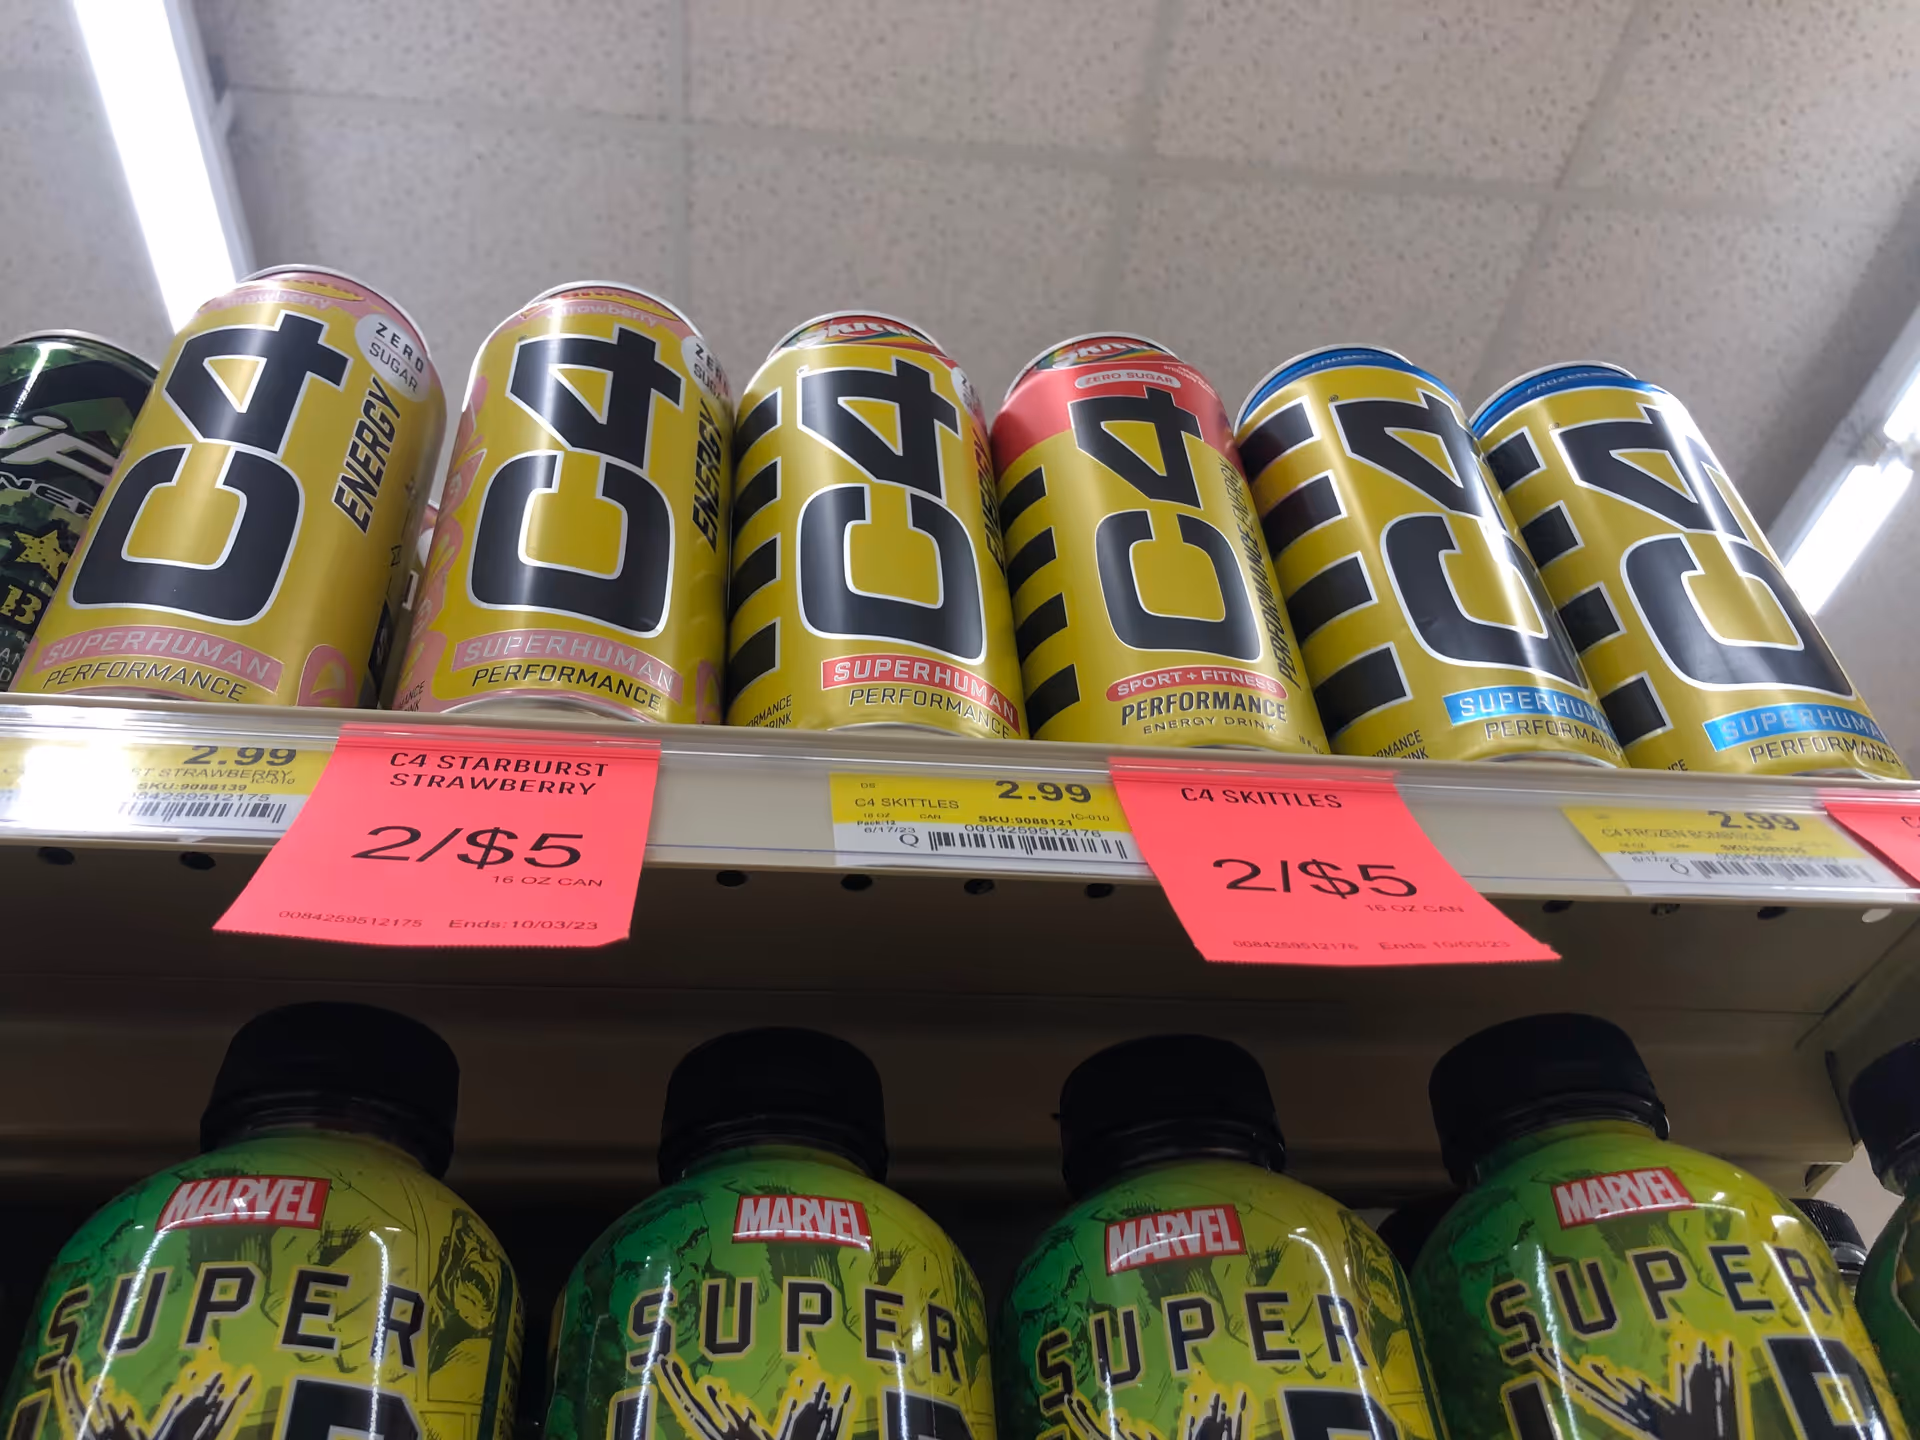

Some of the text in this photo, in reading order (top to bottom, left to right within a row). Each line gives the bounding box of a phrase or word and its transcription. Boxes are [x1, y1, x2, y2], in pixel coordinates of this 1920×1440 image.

[367, 341, 420, 393] SUGAR
[374, 321, 425, 375] ZERO
[1085, 372, 1173, 385] ZERO SUGAR
[69, 311, 354, 626] C4
[331, 376, 402, 536] ENERGY
[691, 397, 726, 553] ENERGY
[468, 324, 684, 639] C4
[796, 355, 987, 665] C4
[1066, 386, 1262, 663] C4
[1328, 388, 1589, 690] C4
[1549, 402, 1857, 700] C4
[43, 629, 272, 682] SUPERHUMAN
[463, 634, 675, 691] SUPERHUMAN
[41, 658, 250, 703] PERFORMANCE
[471, 663, 662, 712] PERFORMANCE
[833, 659, 1016, 722] SUPERHUMAN
[1117, 672, 1180, 696] SPORT
[1201, 669, 1280, 694] FITNESS
[848, 687, 1011, 740] PERFORMANCE
[1121, 691, 1287, 726] PERFORMANCE
[1143, 716, 1279, 735] ENERGY DRINK
[182, 745, 298, 767] 2.99
[390, 752, 609, 777] C4 STARBURST
[132, 791, 271, 802] 84259512175
[390, 773, 597, 796] STRAWBERRY
[855, 797, 959, 810] C4 SKITTLES
[995, 780, 1092, 803] 2.99
[1181, 787, 1343, 810] C4 SKITTLES
[899, 832, 921, 849] Q
[1707, 809, 1801, 831] 2.99
[351, 825, 584, 870] 2/$5
[493, 875, 603, 887] 16 OZ CAN
[1213, 858, 1418, 900] 2/$5
[1366, 903, 1387, 912] 16
[1423, 904, 1464, 912] CAN
[164, 1177, 318, 1224] MARVEL
[739, 1197, 870, 1246] MARVEL
[1555, 1170, 1692, 1227] MARVEL
[1108, 1207, 1243, 1274] MARVEL
[35, 1261, 426, 1379] SUPER
[1487, 1244, 1833, 1364] SUPER
[626, 1276, 961, 1383] SUPER
[1034, 1290, 1369, 1413] SUPER
